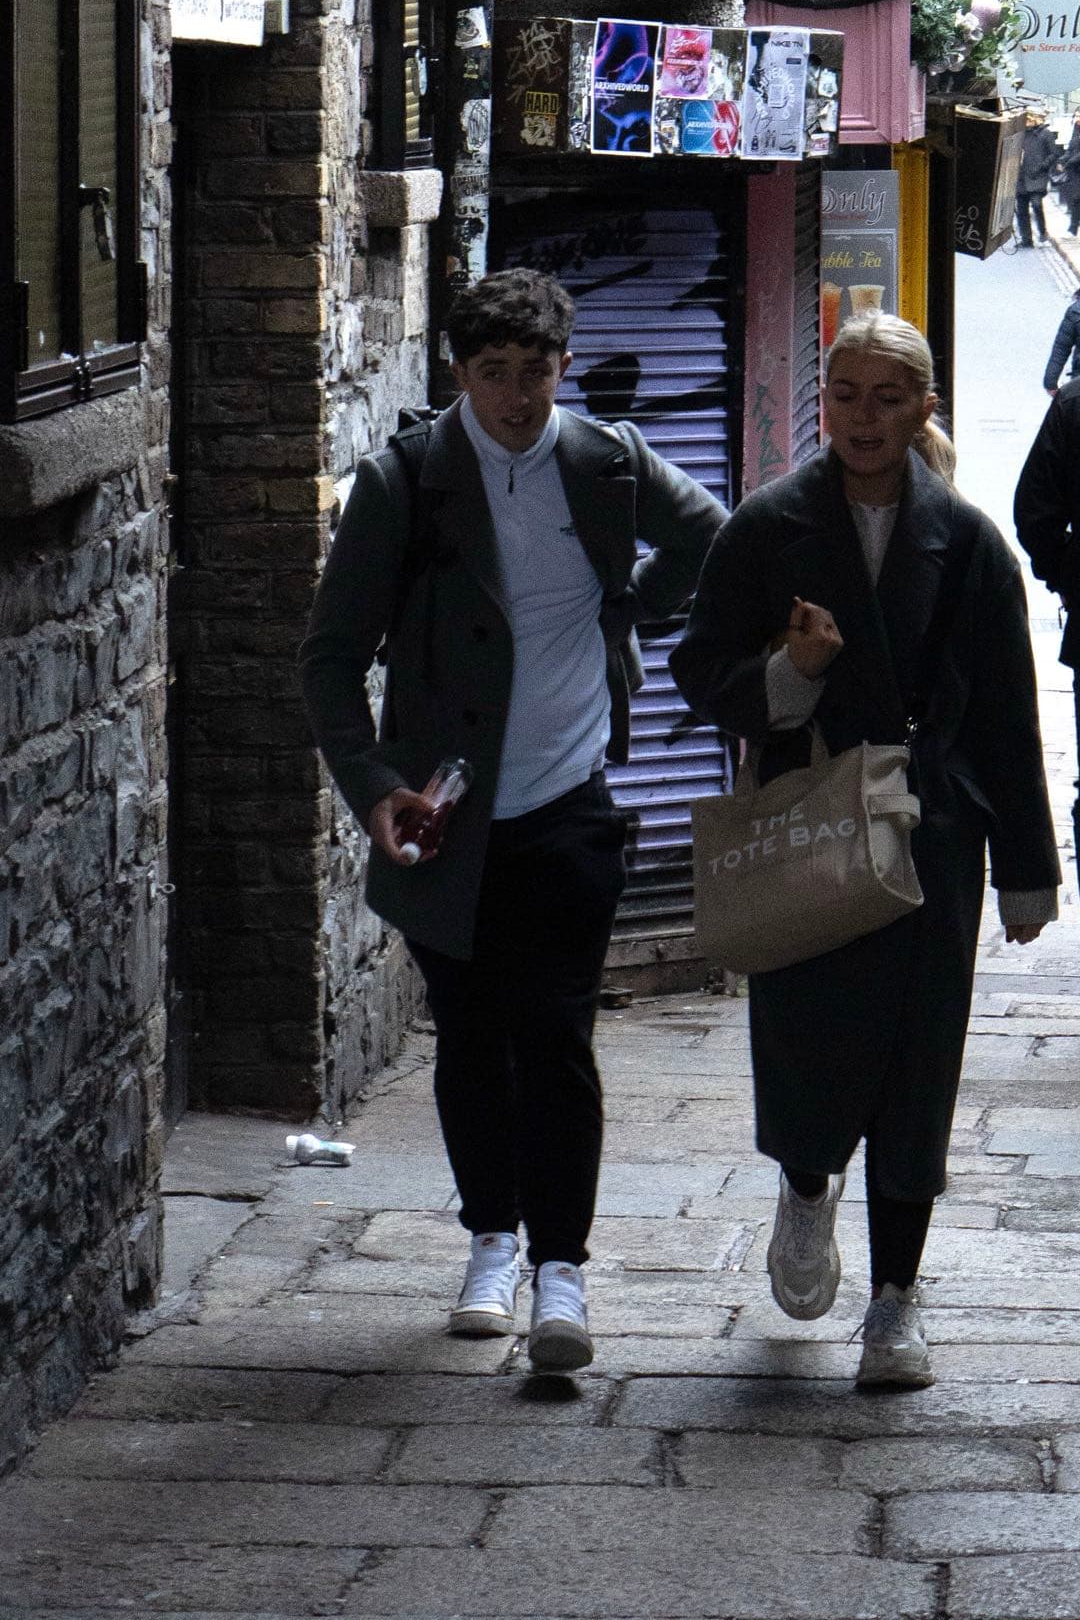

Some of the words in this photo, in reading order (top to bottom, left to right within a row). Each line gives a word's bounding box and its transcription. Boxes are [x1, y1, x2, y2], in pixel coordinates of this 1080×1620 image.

[1039, 42, 1066, 53] Street
[525, 93, 559, 114] HARD
[858, 250, 882, 269] Tea
[751, 802, 804, 835] THE
[709, 835, 777, 876] TOTE
[790, 817, 857, 847] BAG
